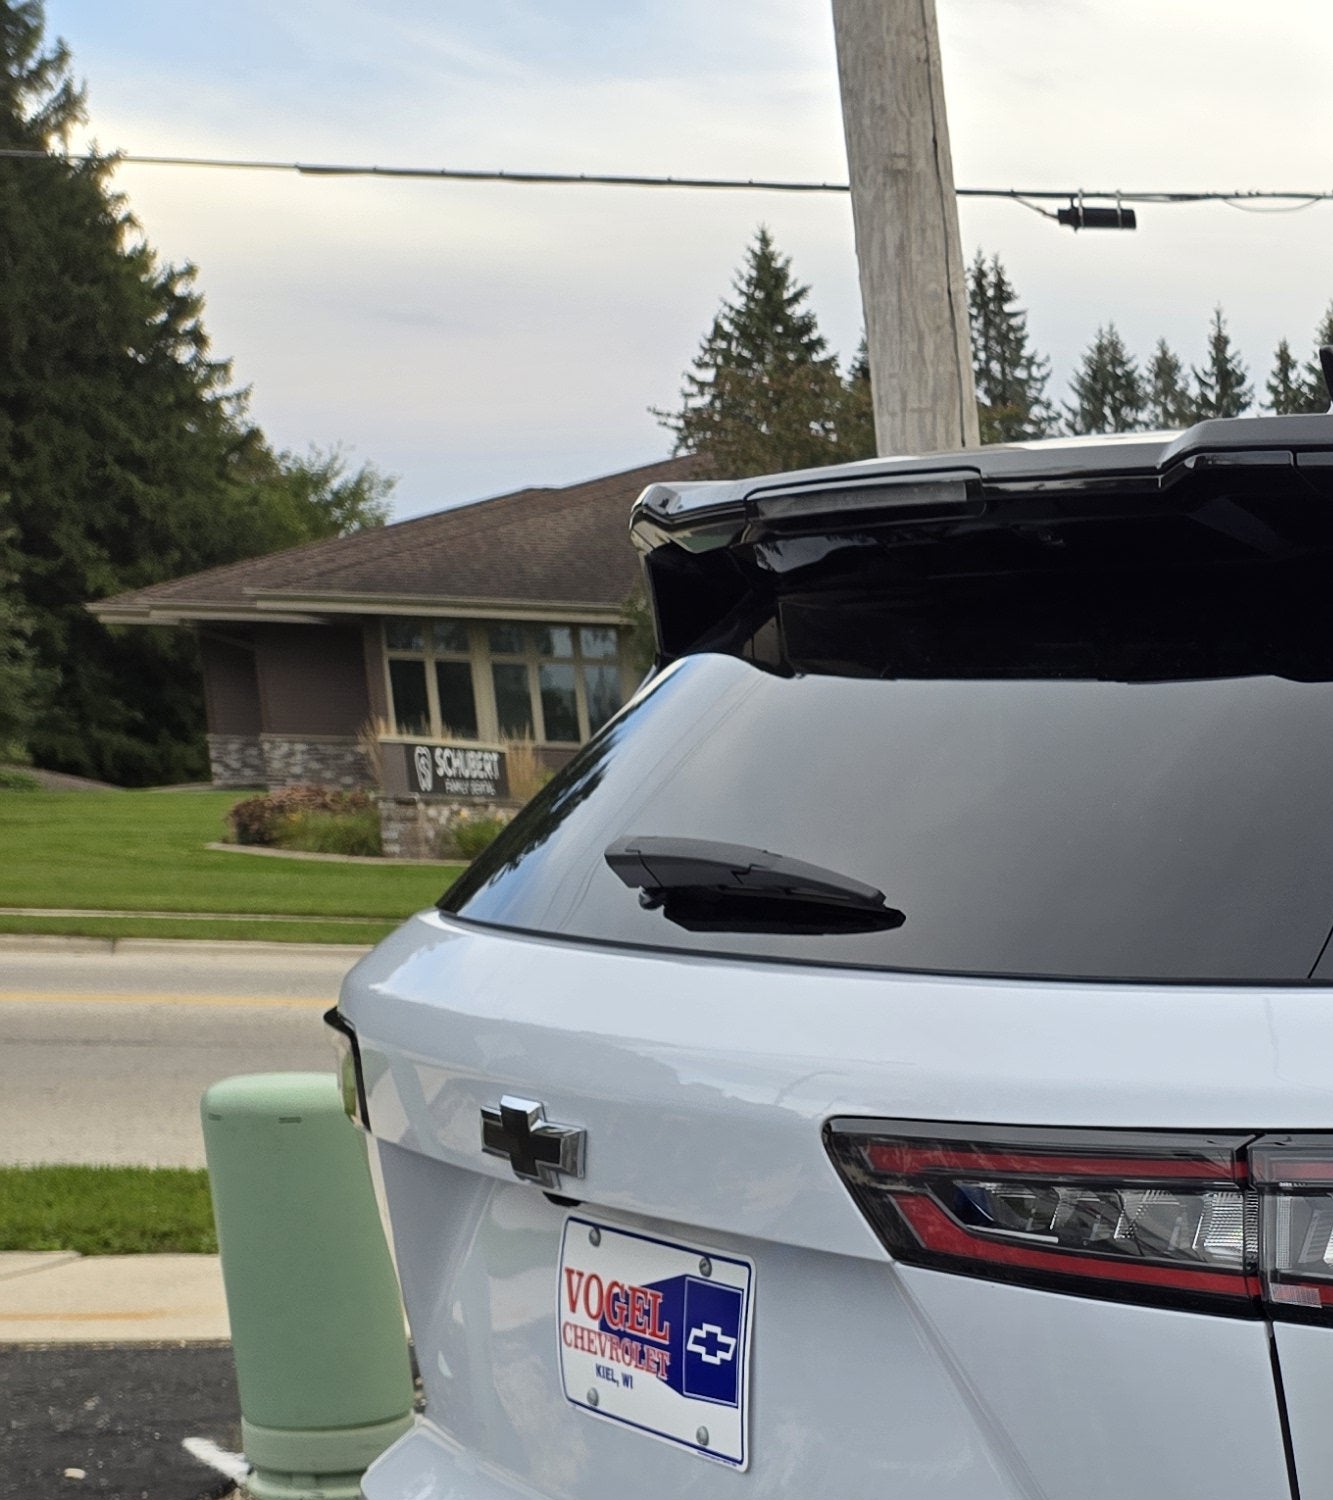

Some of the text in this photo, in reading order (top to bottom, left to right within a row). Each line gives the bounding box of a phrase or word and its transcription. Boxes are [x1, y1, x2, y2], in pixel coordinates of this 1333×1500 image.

[434, 747, 500, 780] SCHUBERT
[564, 1267, 670, 1344] VOGEL
[563, 1321, 671, 1381] CHEVROLET
[621, 1373, 634, 1389] WI
